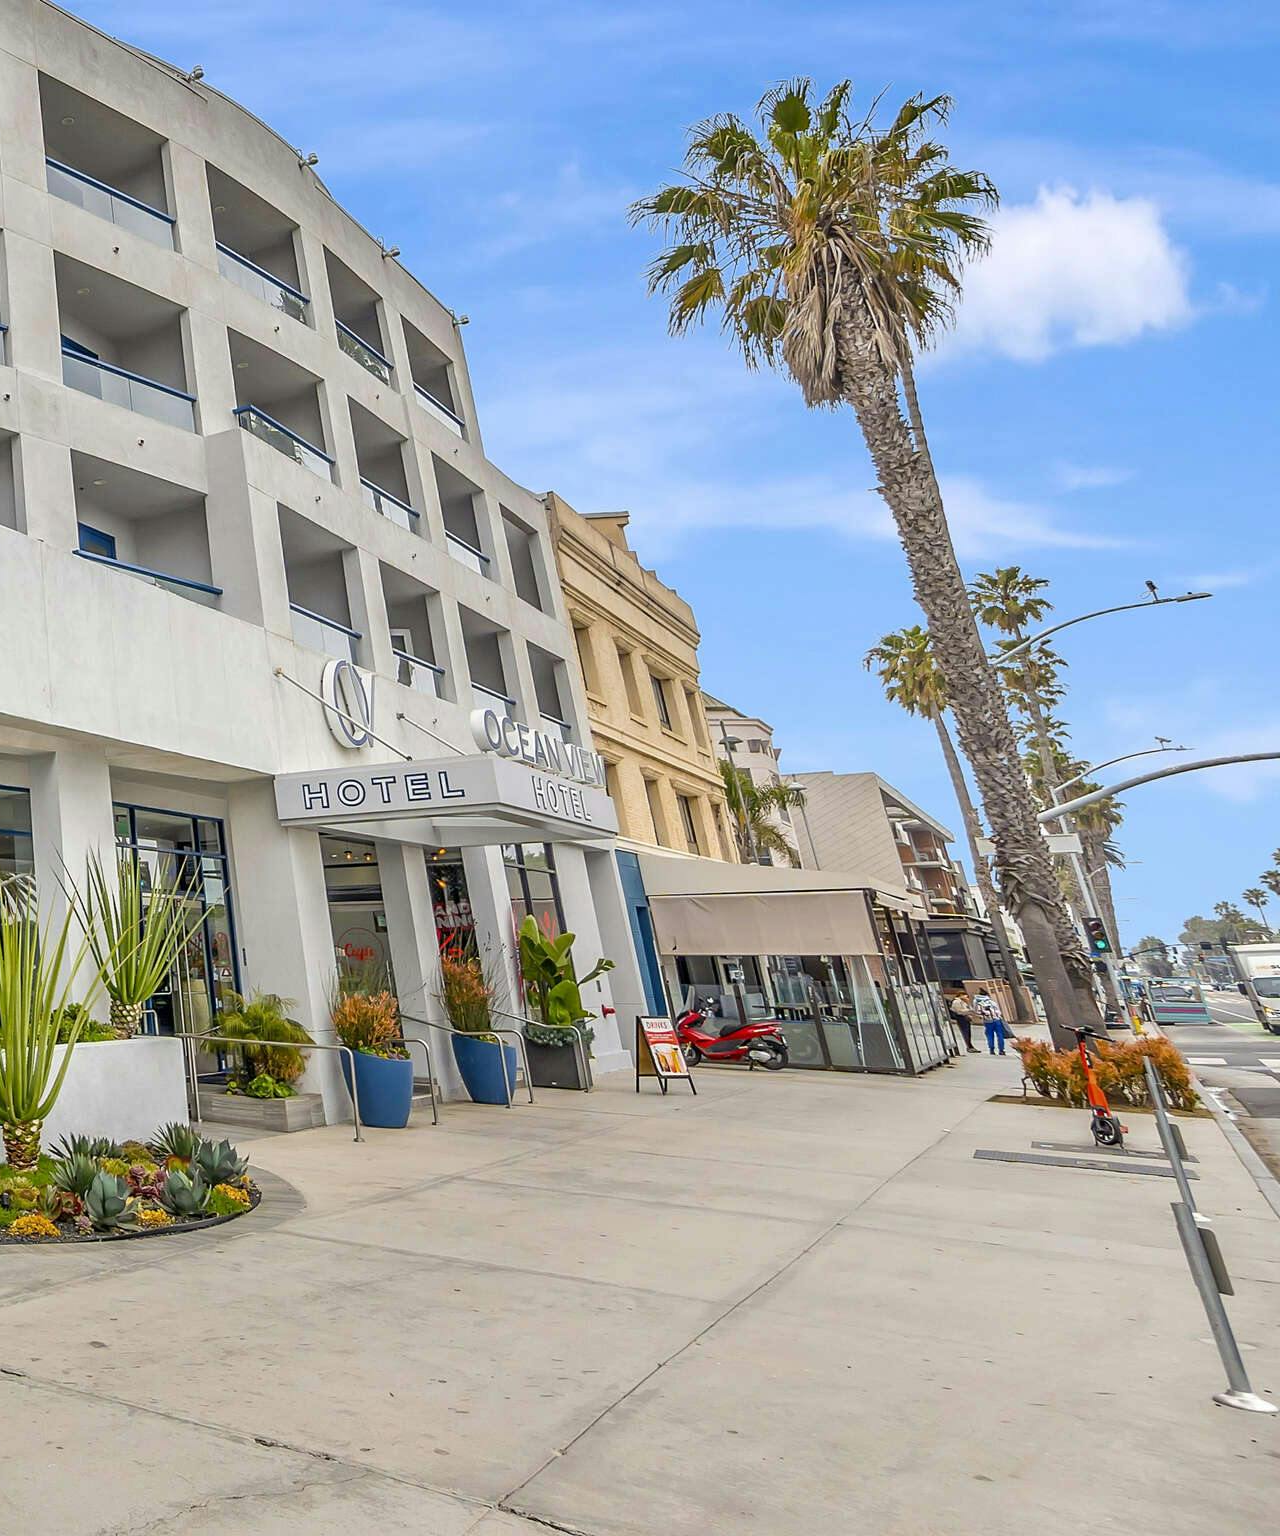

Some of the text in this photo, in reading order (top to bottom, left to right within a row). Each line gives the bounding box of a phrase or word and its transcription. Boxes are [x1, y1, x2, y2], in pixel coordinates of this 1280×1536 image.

[470, 707, 607, 788] OCEAN VIEW
[301, 770, 466, 811] HOTEL
[531, 775, 592, 823] HOTEL
